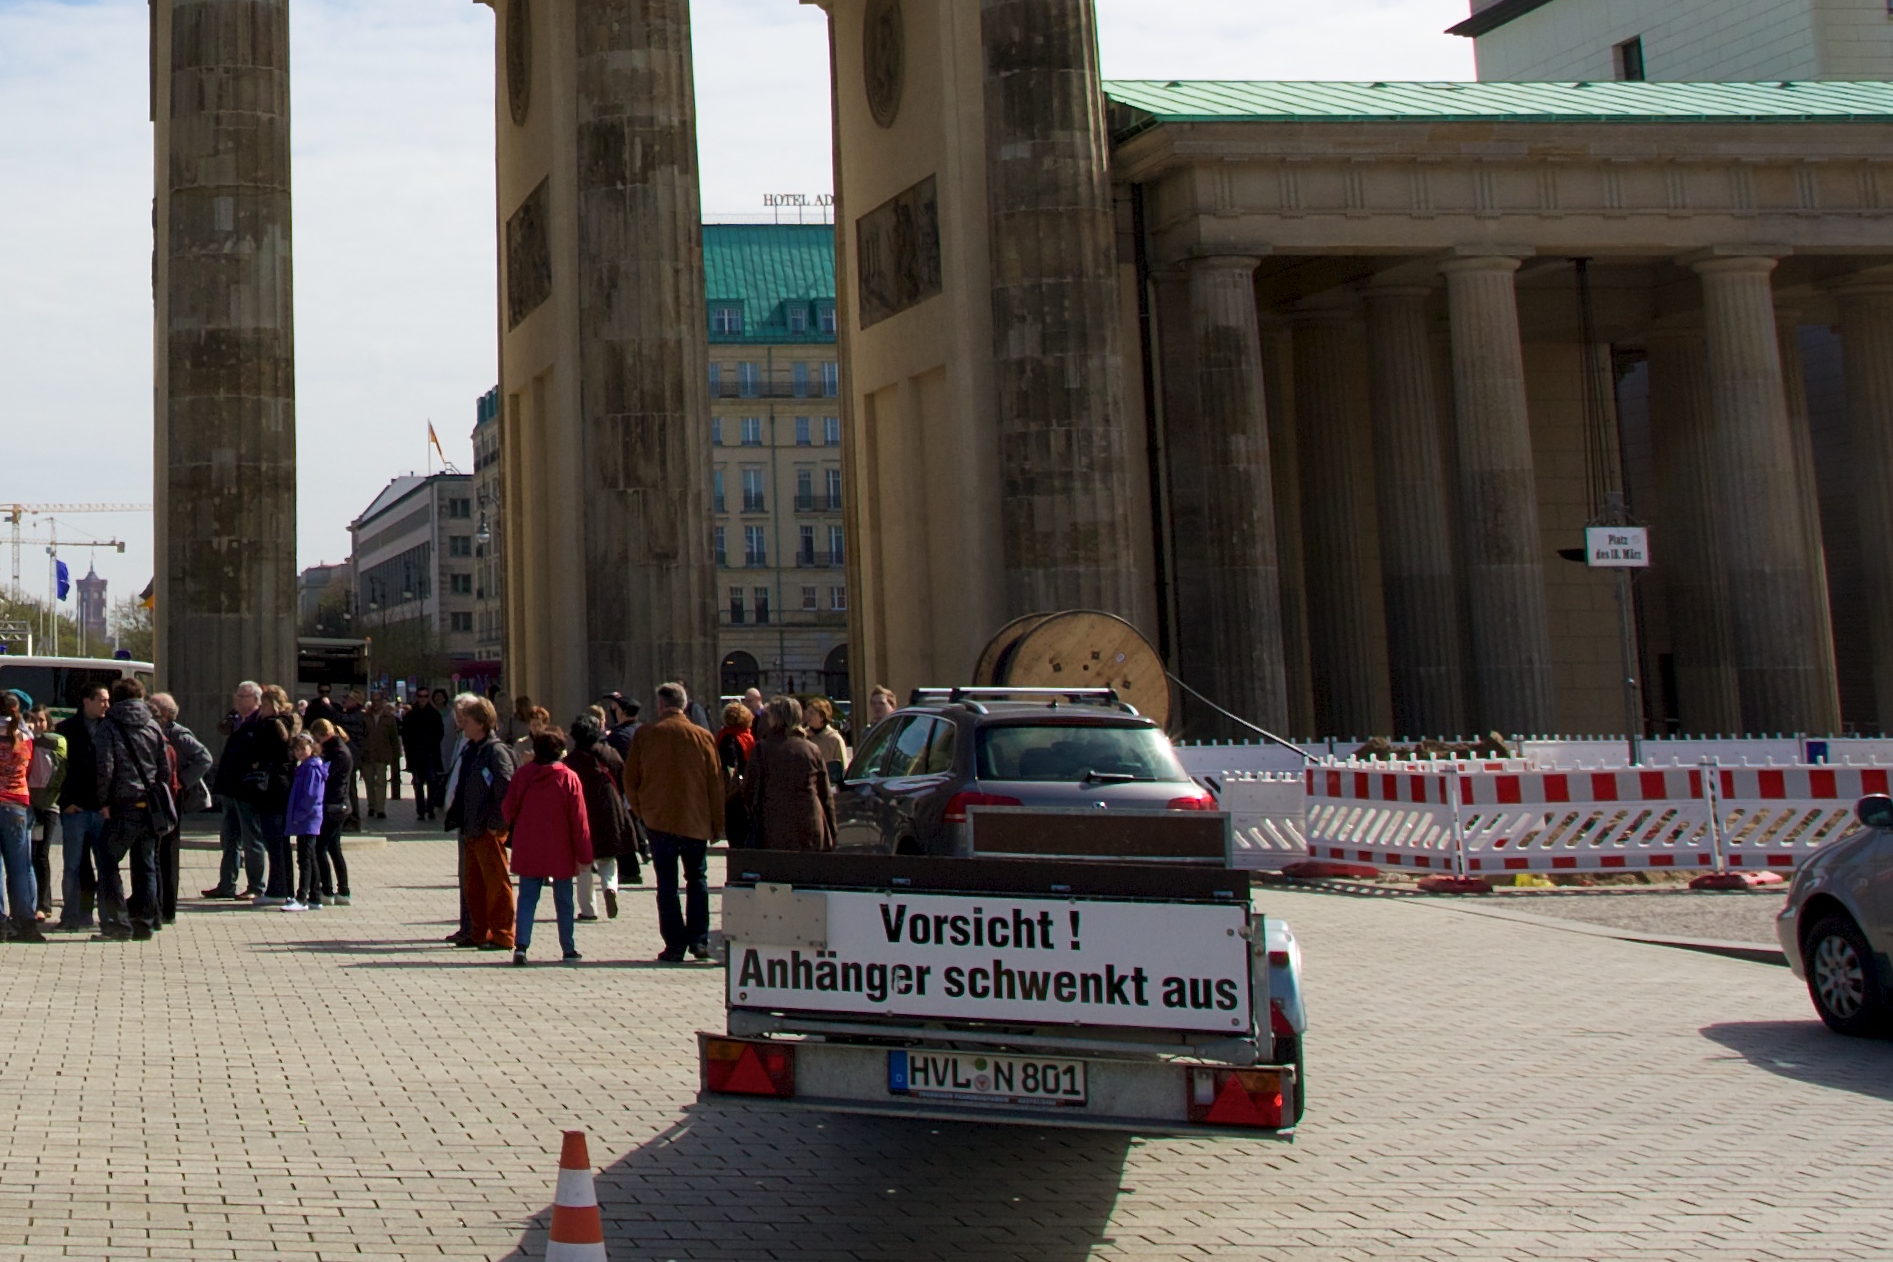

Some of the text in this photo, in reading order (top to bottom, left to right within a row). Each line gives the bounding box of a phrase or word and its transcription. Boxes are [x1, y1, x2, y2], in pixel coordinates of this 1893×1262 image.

[763, 194, 810, 206] HOTEL
[1608, 534, 1628, 545] Platz
[1596, 549, 1609, 560] des
[1622, 549, 1642, 560] März
[879, 903, 1081, 951] Vorsicht !
[738, 948, 1238, 1011] Anhänger schwenkt aus
[895, 1073, 903, 1083] D
[909, 1055, 1081, 1096] HVL N 801
